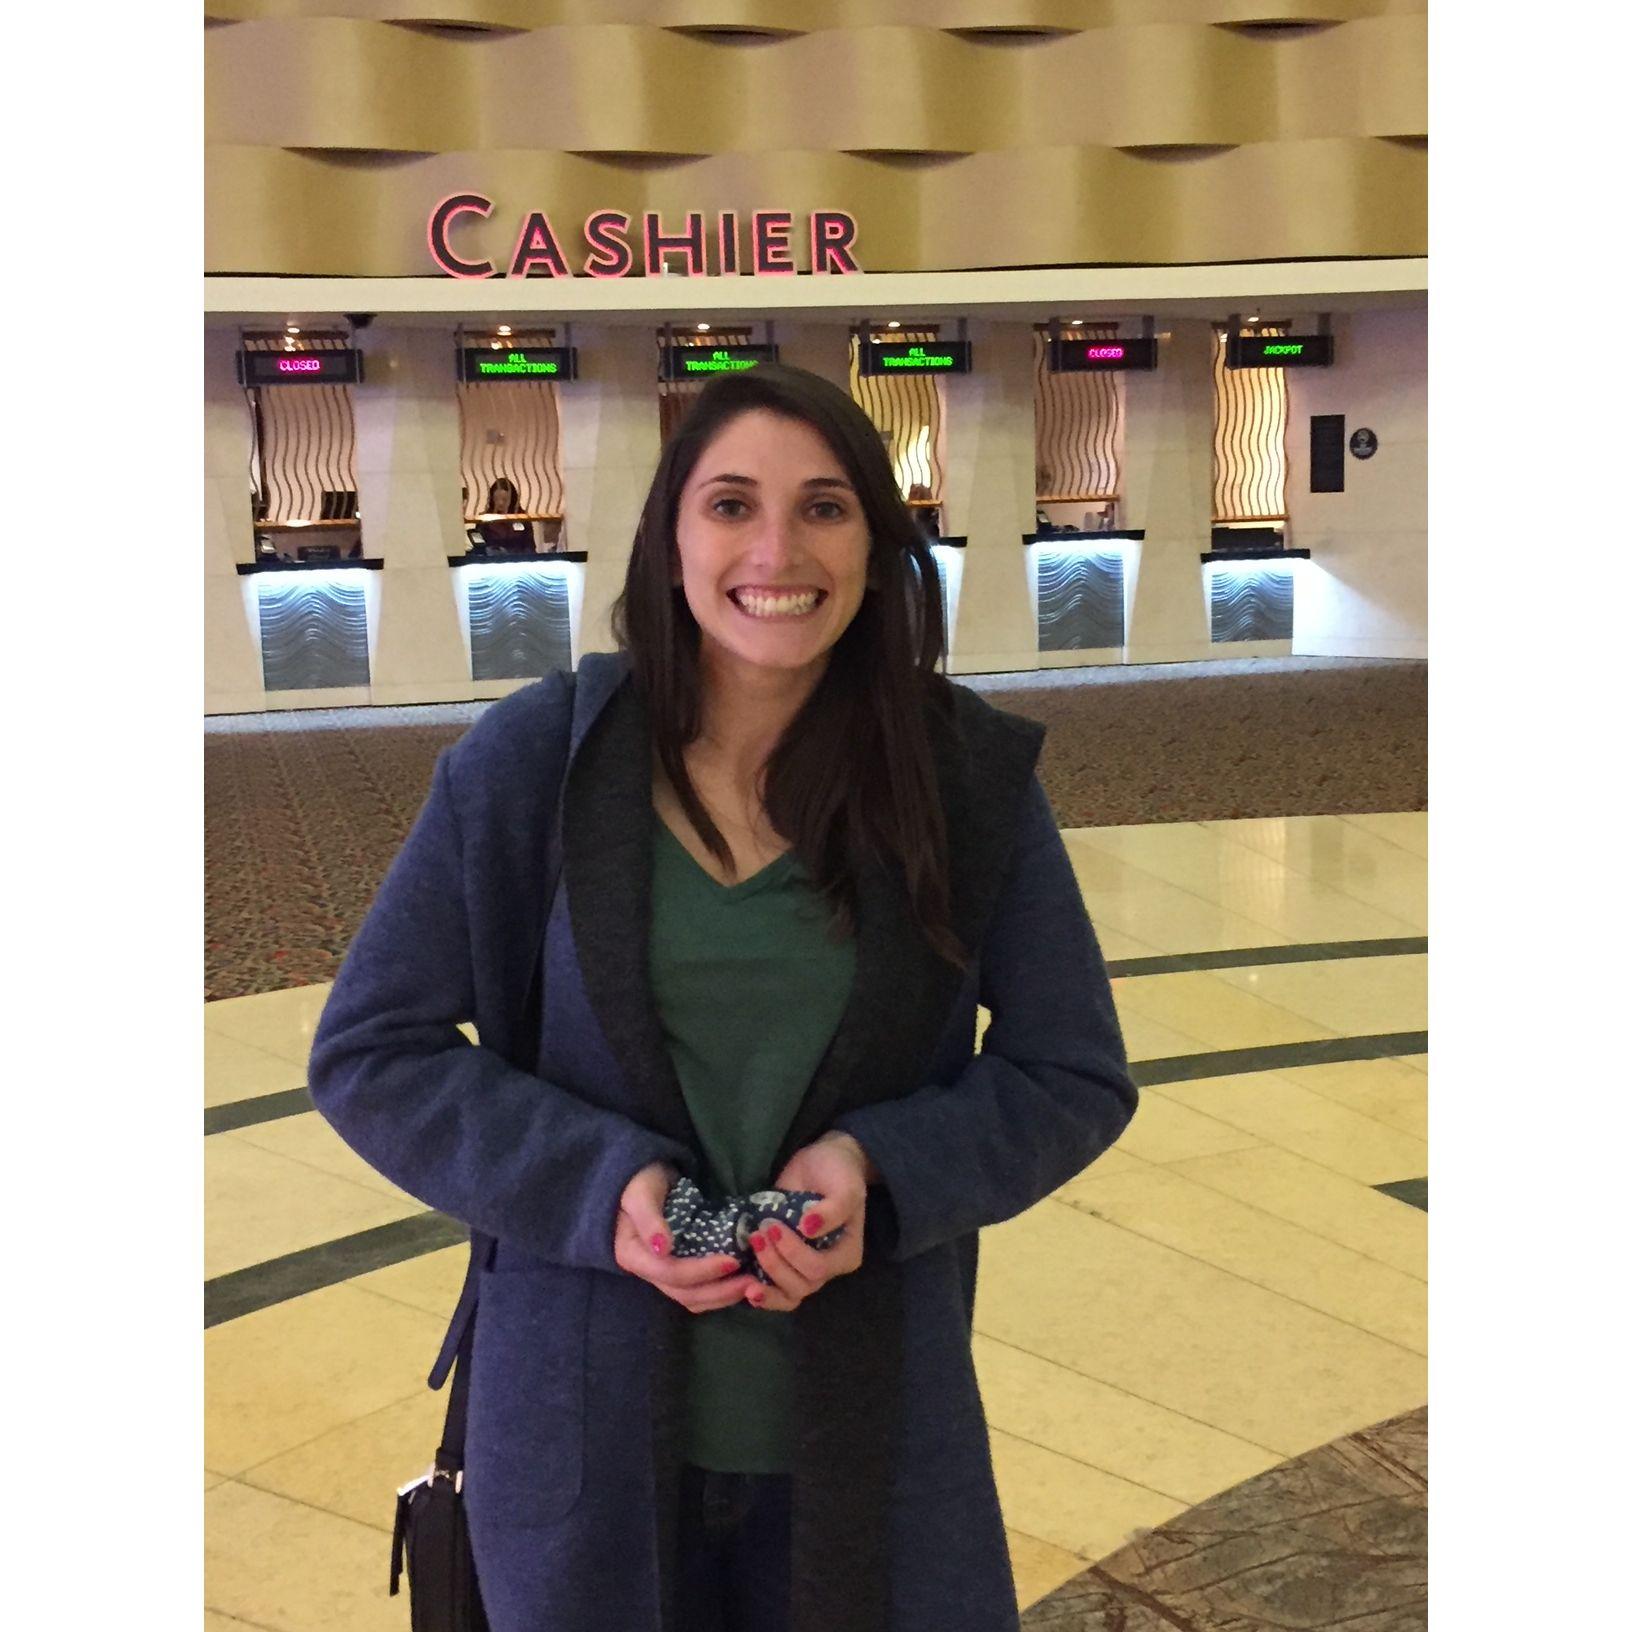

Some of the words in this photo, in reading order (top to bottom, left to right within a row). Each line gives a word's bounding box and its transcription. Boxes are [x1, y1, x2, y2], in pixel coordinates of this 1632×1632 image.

[427, 193, 863, 279] CASHIER
[908, 347, 926, 356] ALL
[1088, 348, 1123, 358] CLOSED
[1263, 344, 1303, 355] JACKPOT
[508, 353, 526, 363] ALL
[712, 351, 729, 361] ALL
[882, 356, 953, 366] TRANSACTIONS
[279, 360, 320, 371] CLOSED
[479, 363, 557, 373] TRANSACTIONS
